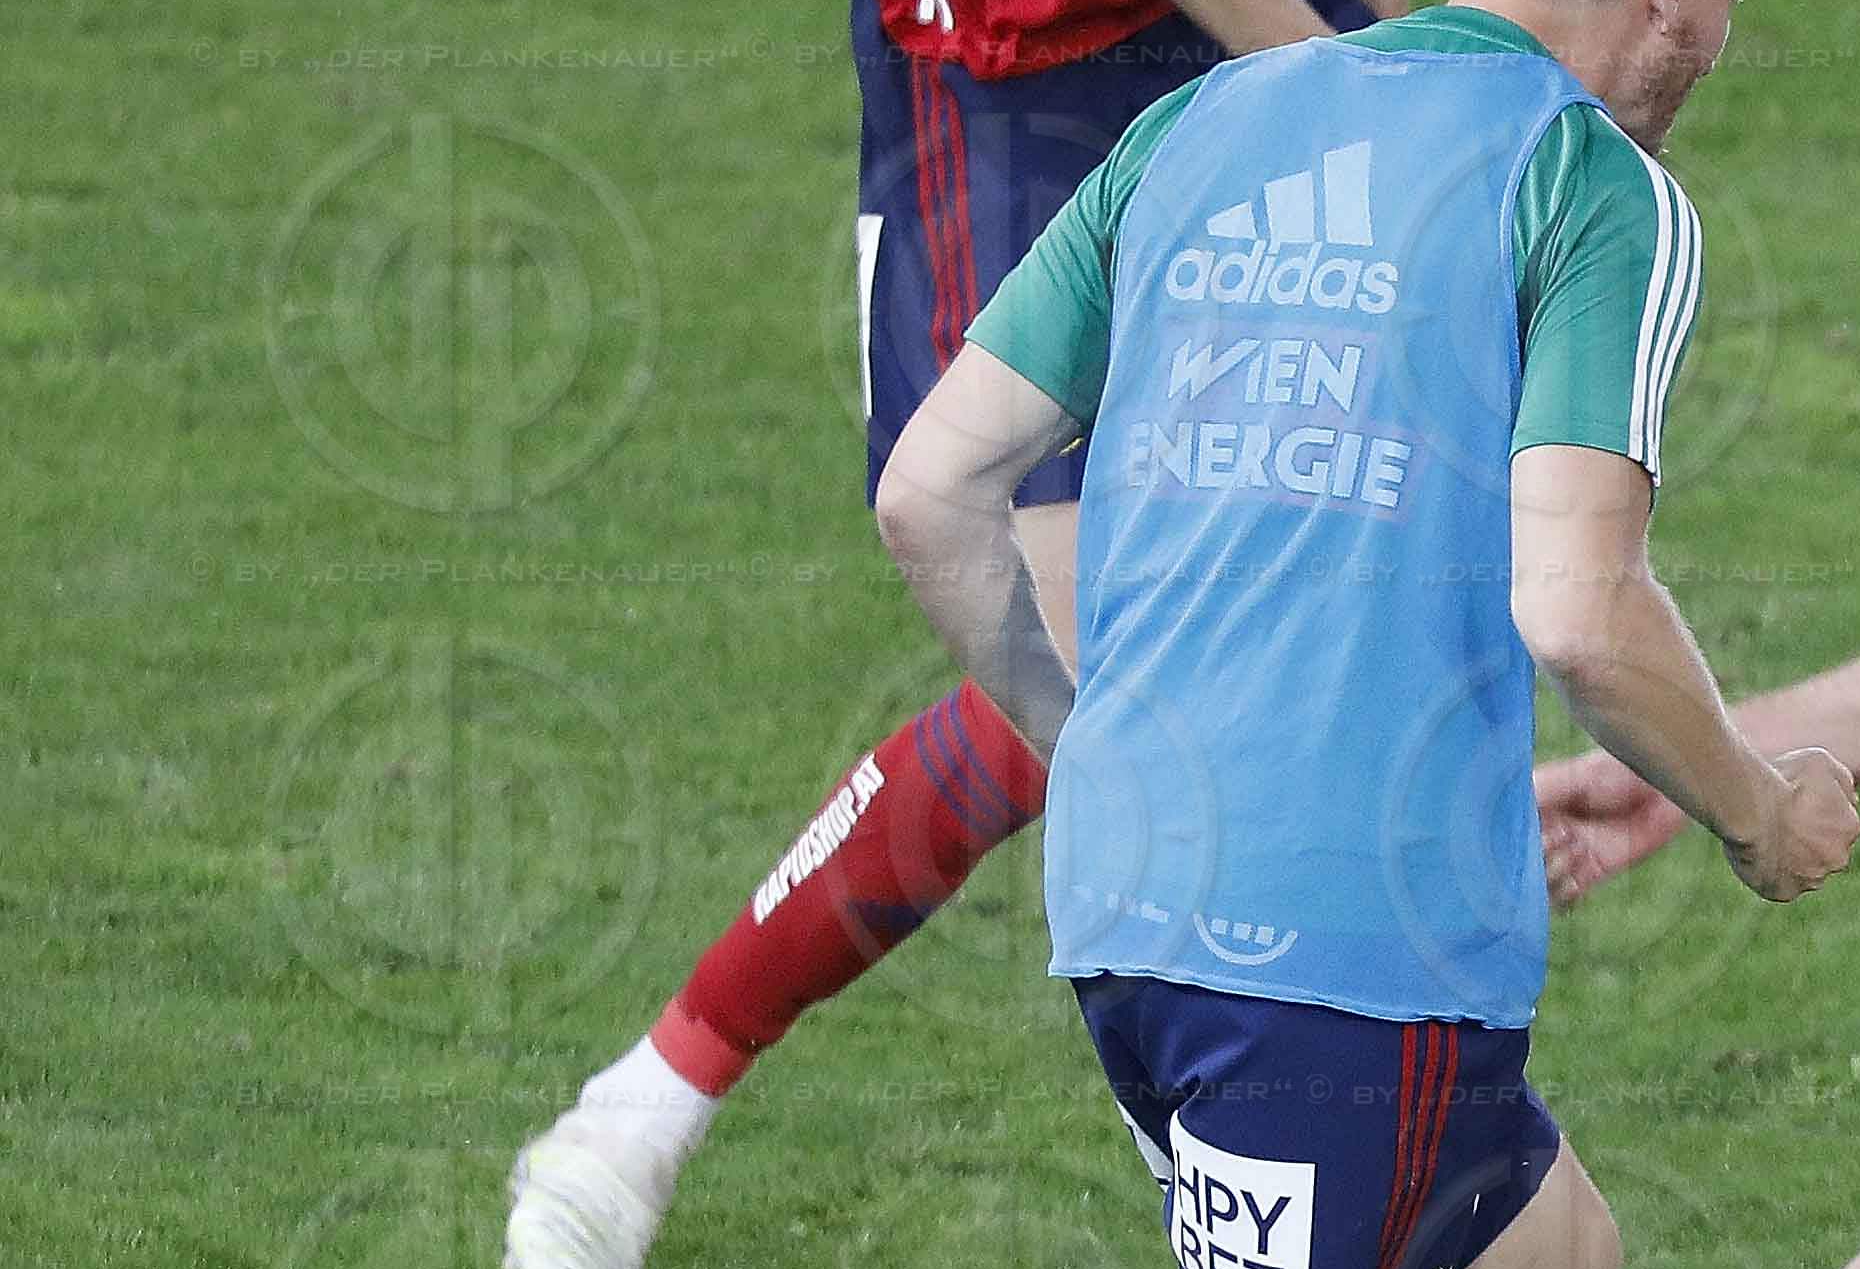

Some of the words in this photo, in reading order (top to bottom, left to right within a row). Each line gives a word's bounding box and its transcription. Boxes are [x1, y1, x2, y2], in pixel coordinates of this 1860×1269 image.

[1165, 239, 1399, 315] adidas
[1168, 337, 1363, 413] WIEN
[1126, 420, 1412, 508] ENERGIE
[1174, 1148, 1292, 1256] HPY
